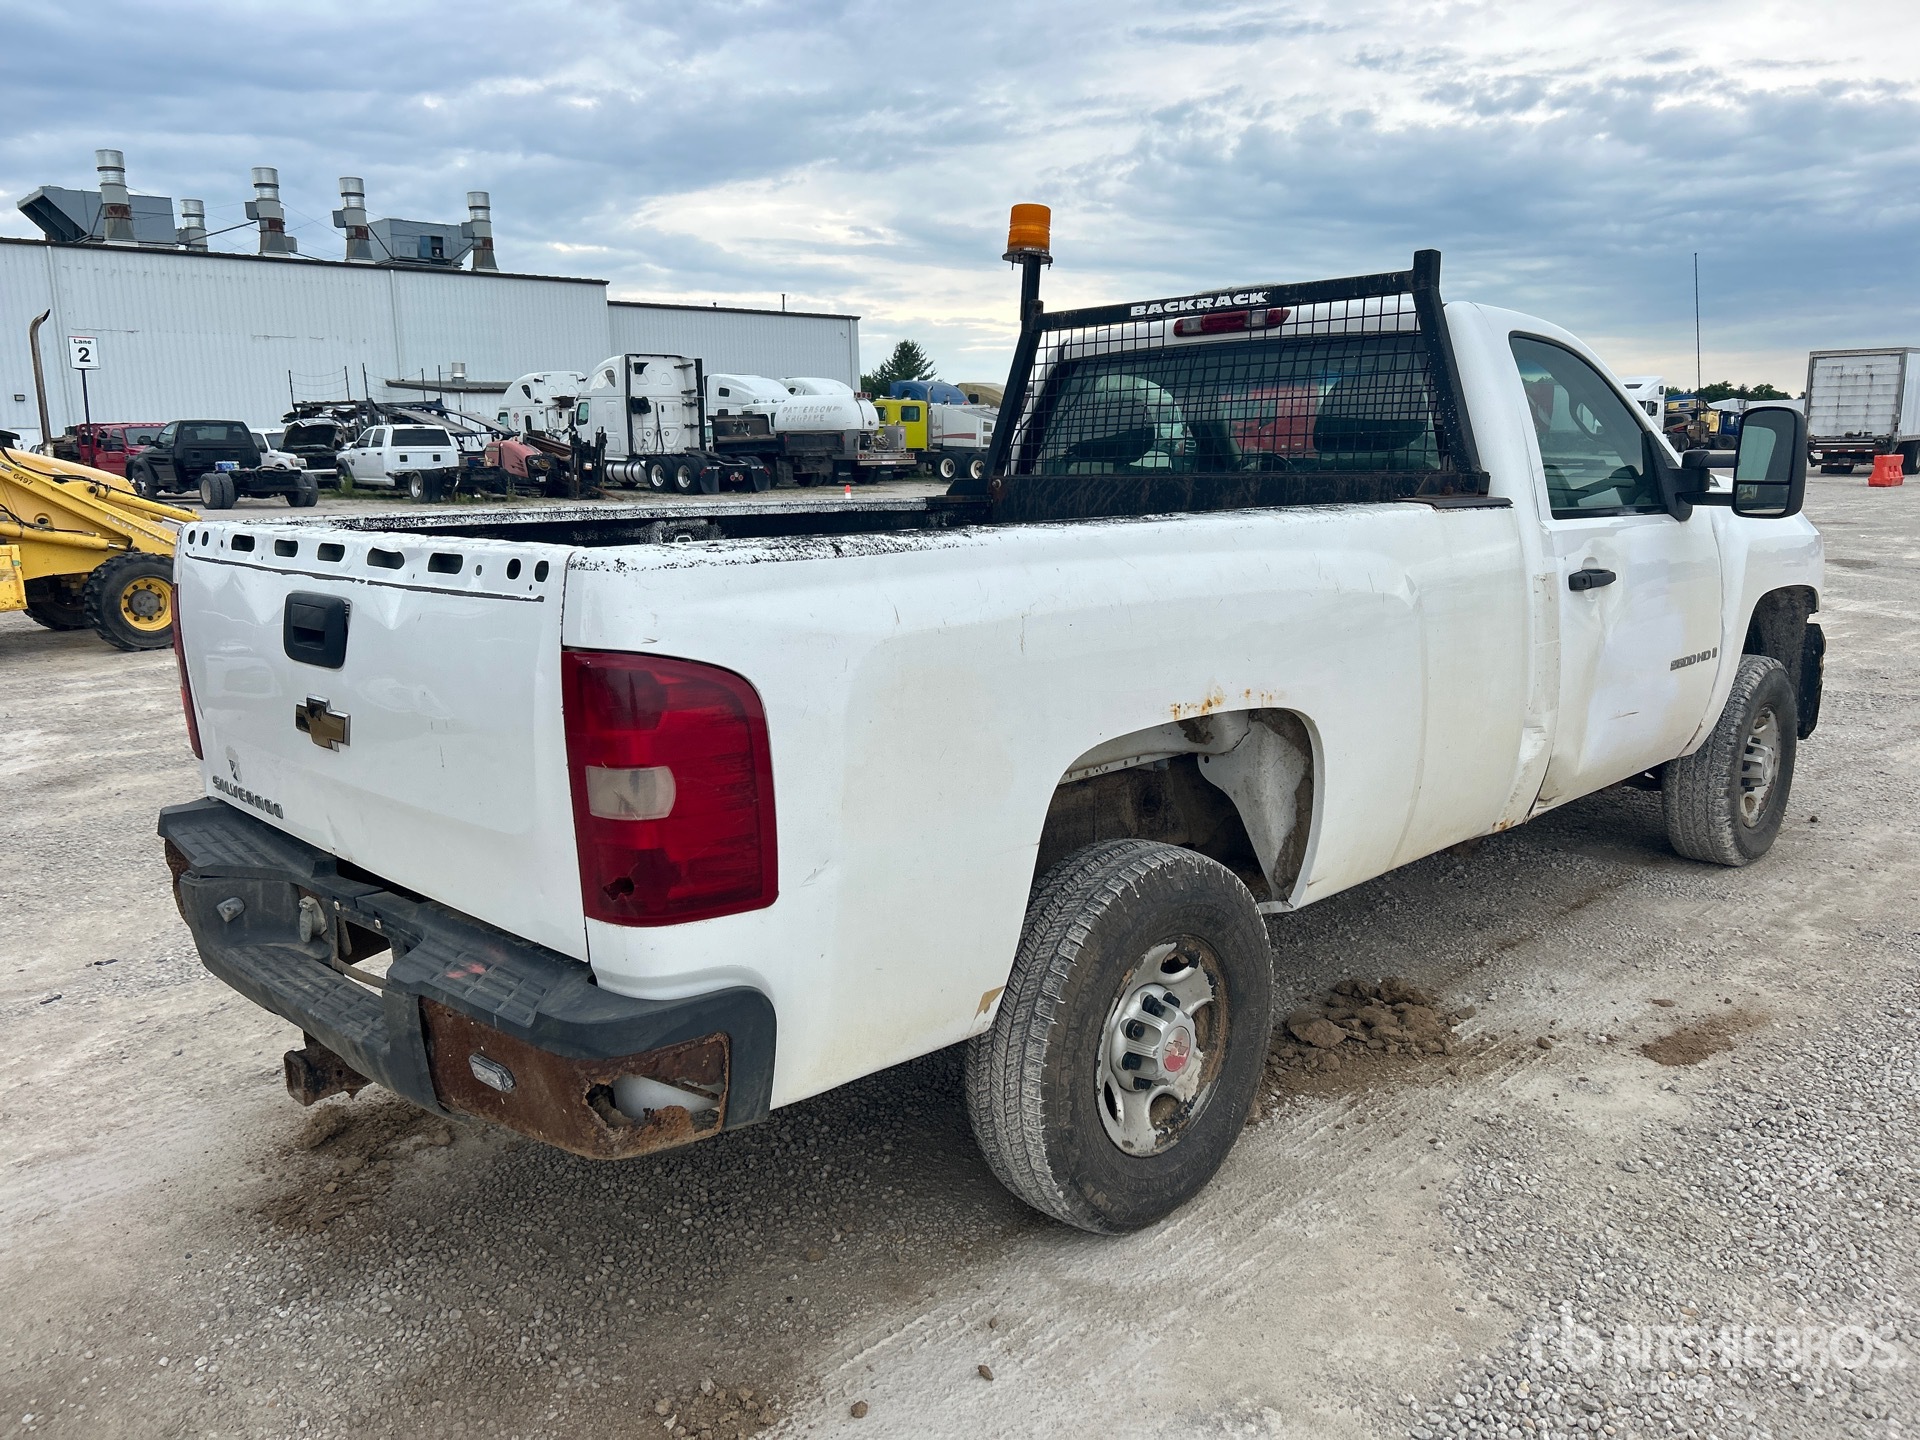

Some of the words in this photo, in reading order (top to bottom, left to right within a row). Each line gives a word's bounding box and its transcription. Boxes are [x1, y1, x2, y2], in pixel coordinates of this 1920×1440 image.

[1130, 292, 1268, 317] BACKRACK
[77, 346, 92, 363] 2
[782, 405, 833, 414] PATTERSON
[13, 473, 34, 486] 6497
